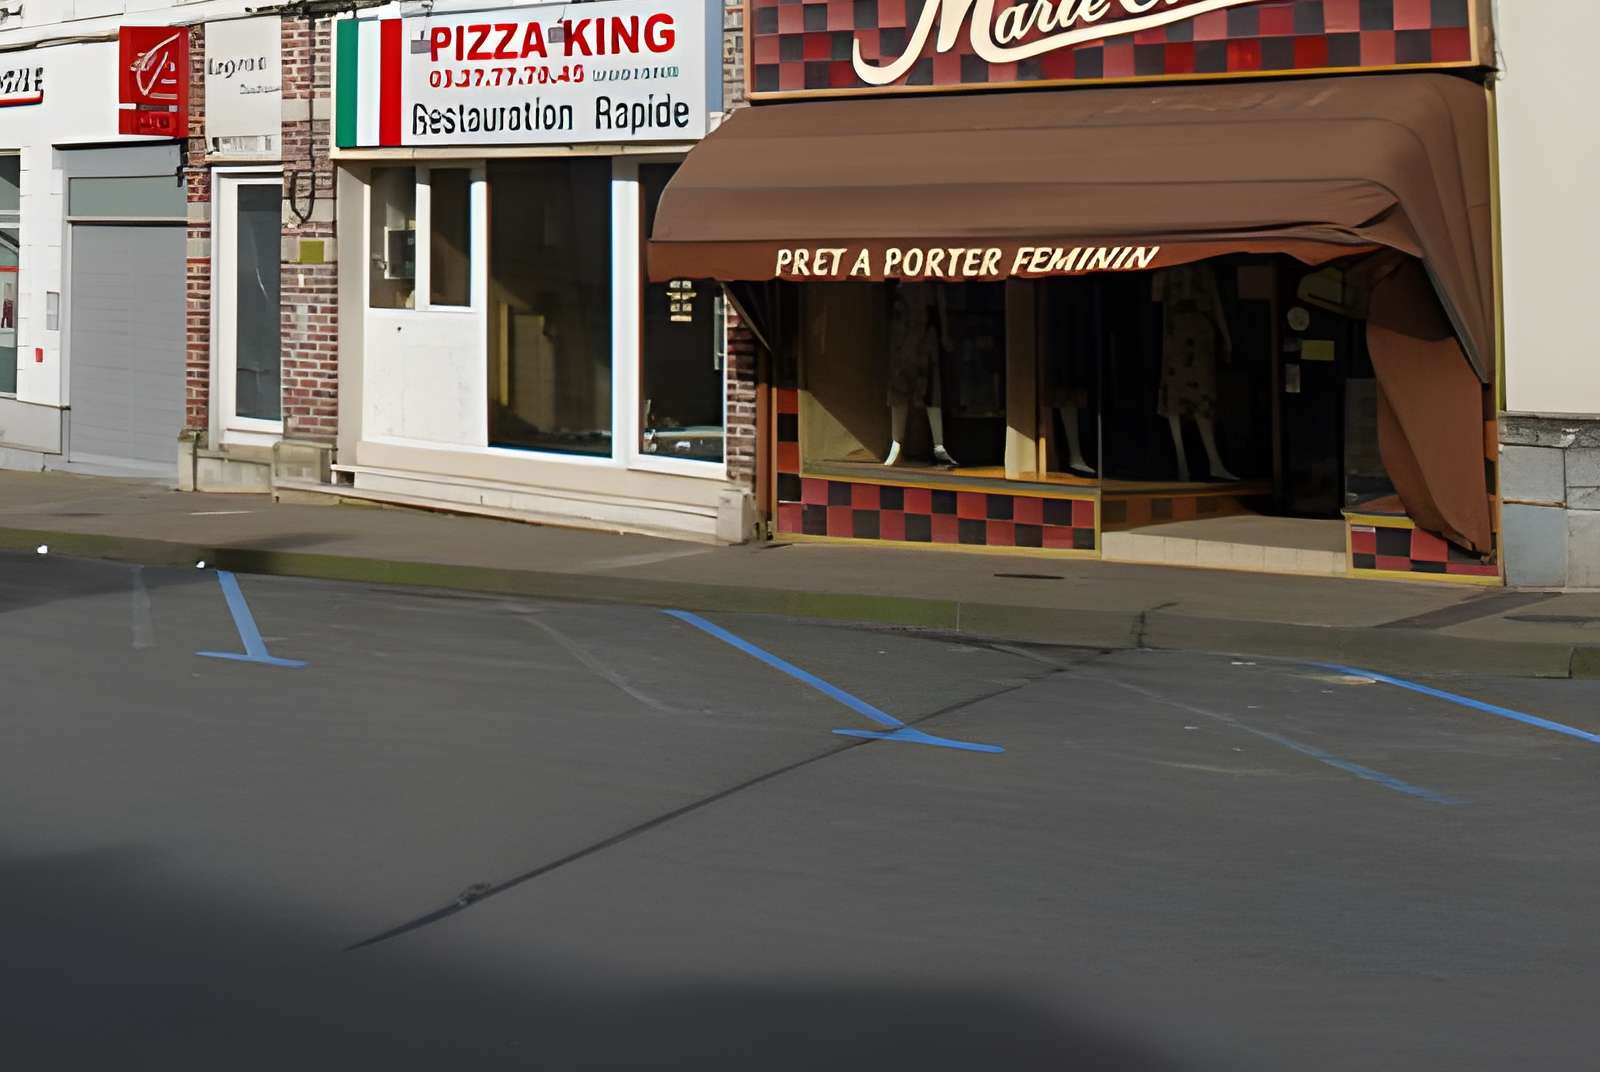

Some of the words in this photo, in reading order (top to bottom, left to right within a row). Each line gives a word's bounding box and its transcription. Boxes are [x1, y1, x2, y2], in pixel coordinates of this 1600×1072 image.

[430, 21, 548, 62] PIZZA
[562, 12, 676, 58] KING
[412, 96, 574, 135] Restauration
[595, 93, 690, 136] Rapide
[775, 247, 848, 277] PRET
[849, 247, 871, 277] A
[883, 246, 1002, 277] PORTER
[1010, 245, 1161, 275] FEMININ
